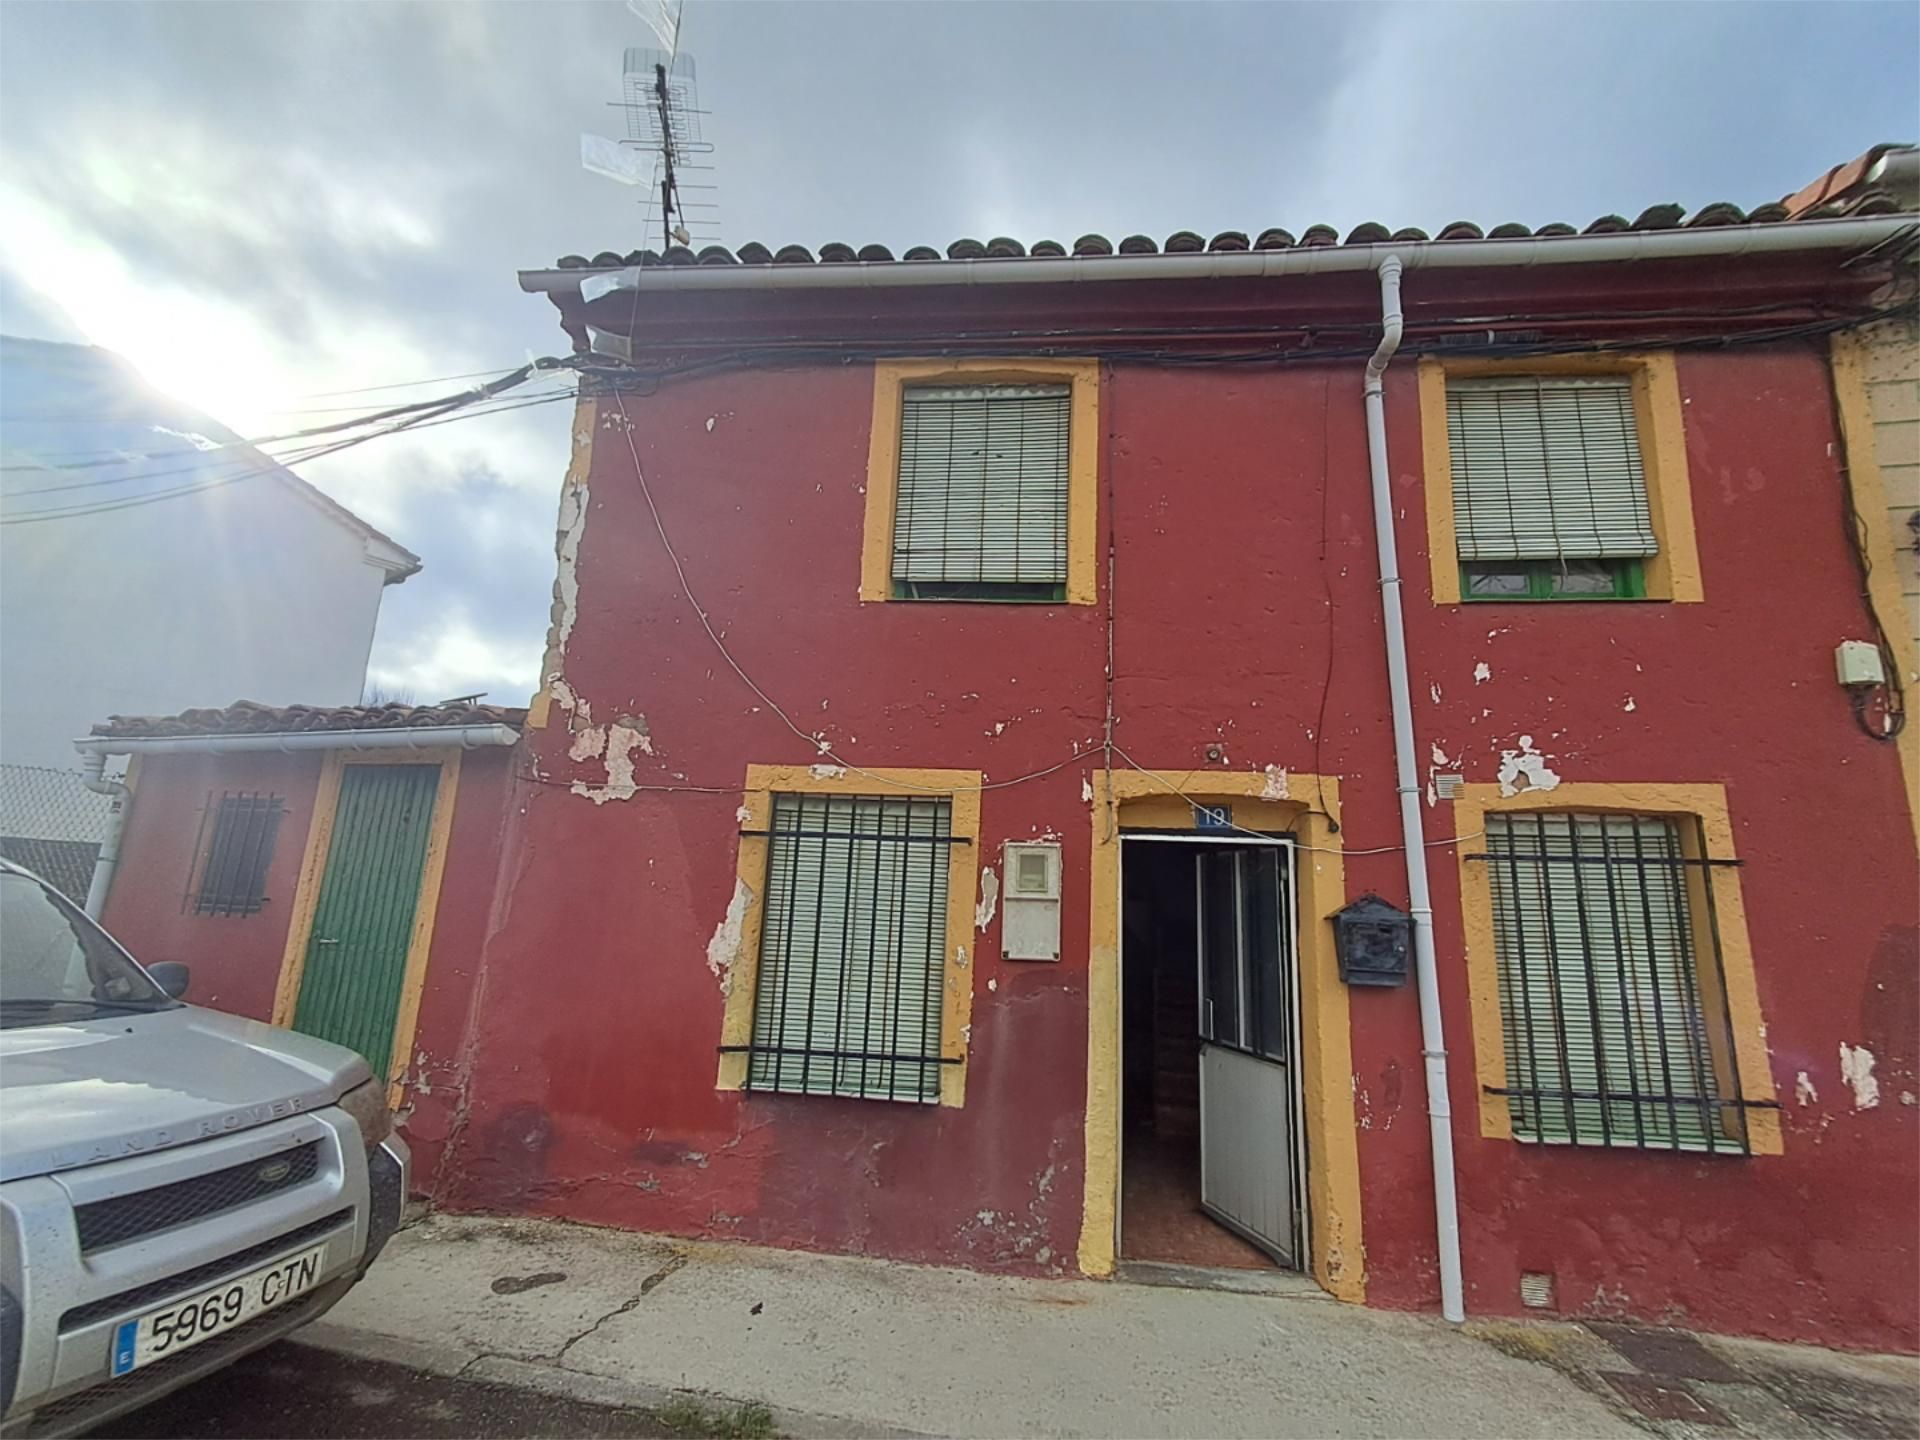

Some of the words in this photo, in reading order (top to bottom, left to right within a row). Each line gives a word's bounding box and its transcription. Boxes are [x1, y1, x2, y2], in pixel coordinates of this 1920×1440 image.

[1203, 807, 1225, 825] 19
[52, 1131, 174, 1168] LAND
[200, 1097, 307, 1136] ROVER
[152, 1285, 244, 1352] 5969
[261, 1252, 319, 1306] CTN
[119, 1352, 131, 1365] E
